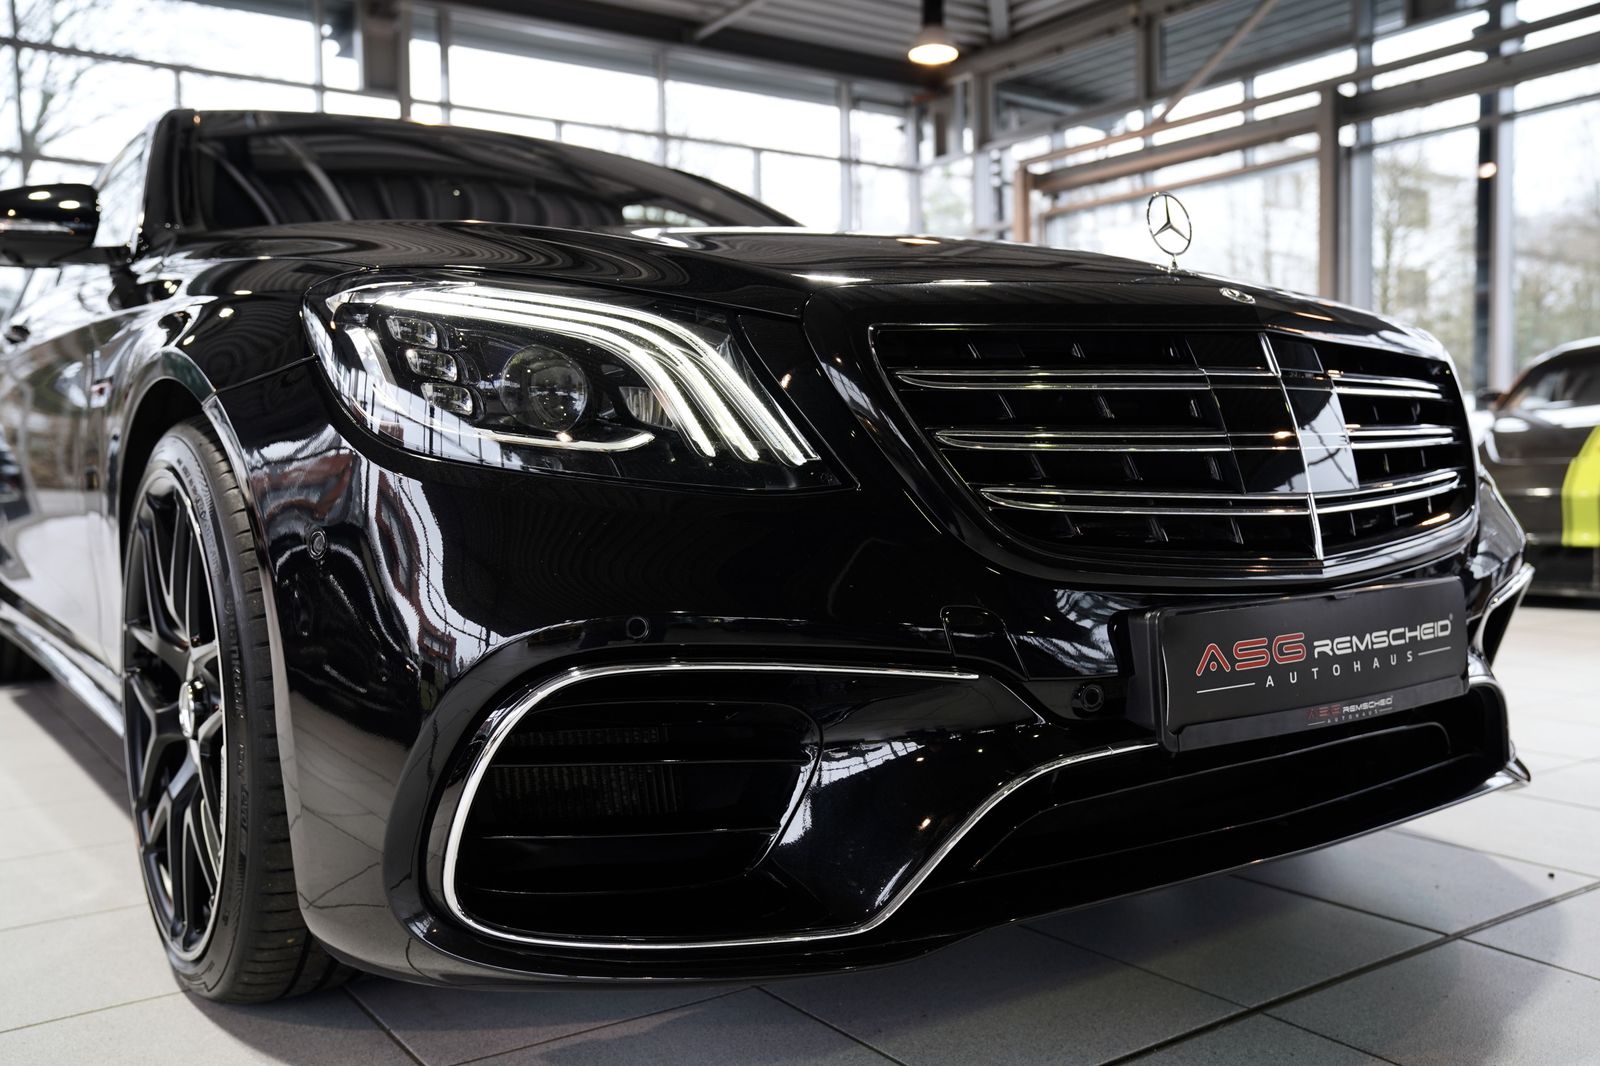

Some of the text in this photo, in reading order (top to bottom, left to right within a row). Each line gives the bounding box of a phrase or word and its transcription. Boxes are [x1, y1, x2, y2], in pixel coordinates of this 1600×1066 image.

[1195, 619, 1452, 678] ASG REMSCHEID
[1265, 650, 1414, 688] AUTOHAUS
